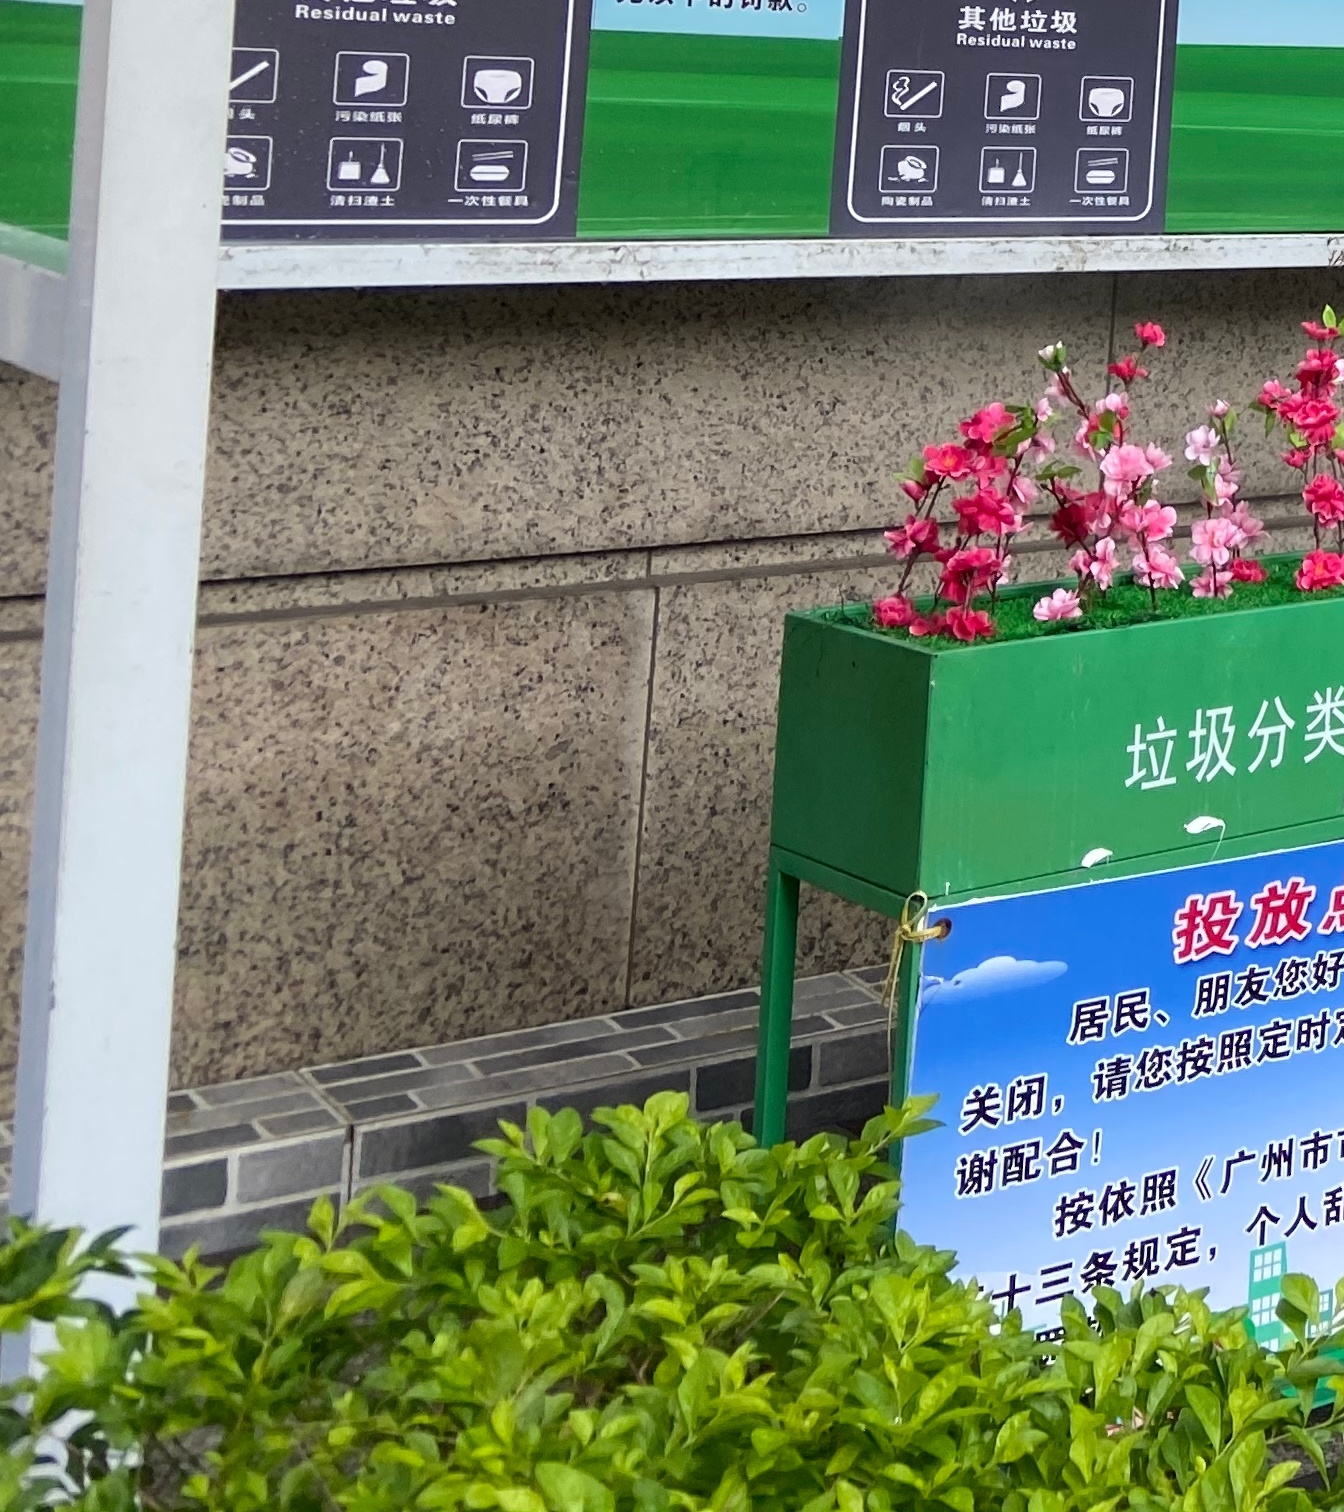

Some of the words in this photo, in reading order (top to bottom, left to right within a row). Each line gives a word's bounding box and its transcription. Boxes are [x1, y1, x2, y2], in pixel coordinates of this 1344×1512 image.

[295, 4, 388, 23] Residual
[393, 11, 456, 26] waste
[957, 6, 1079, 35] 其他垃圾
[956, 33, 1025, 48] Residual
[1029, 38, 1077, 51] waste
